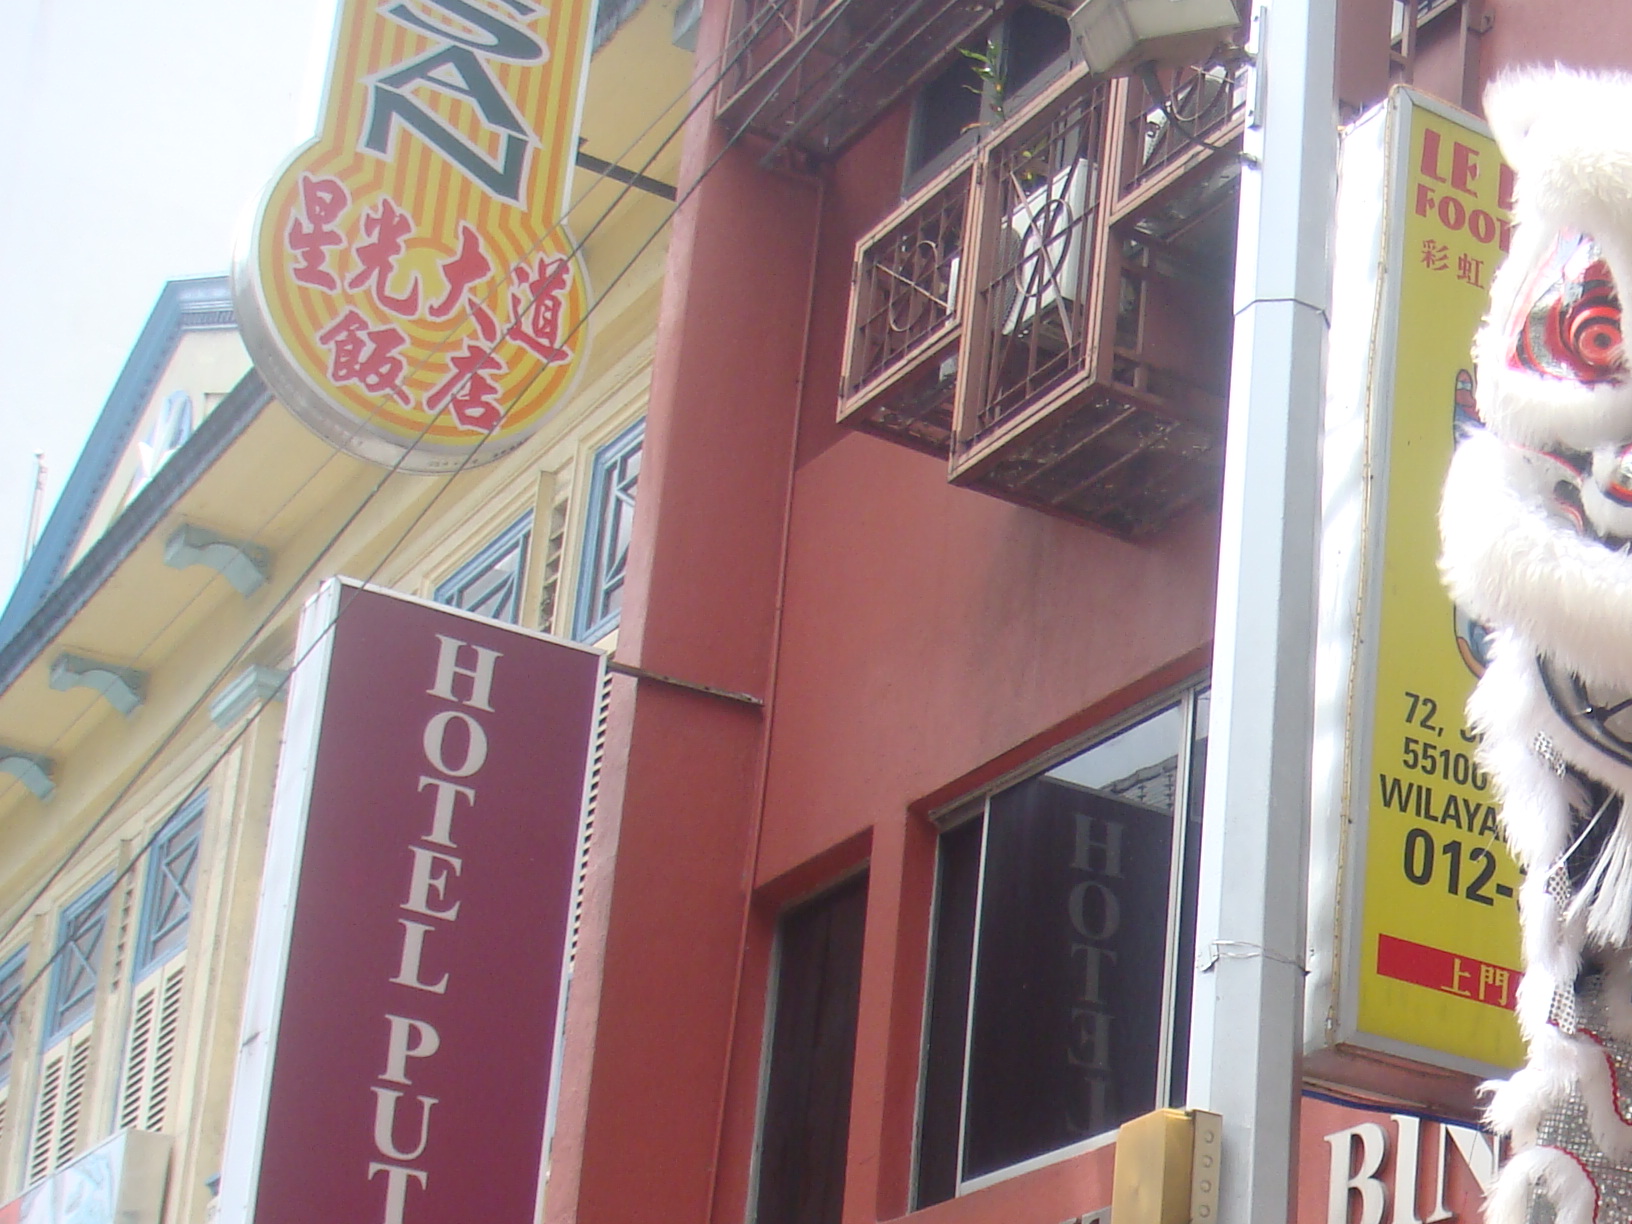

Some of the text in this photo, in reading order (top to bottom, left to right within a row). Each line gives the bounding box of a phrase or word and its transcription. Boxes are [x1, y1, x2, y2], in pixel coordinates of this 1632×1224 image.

[1420, 128, 1482, 199] LE
[287, 171, 573, 366] 星光大道
[1421, 238, 1485, 290] 彩虹
[316, 307, 506, 434] 飯店
[1404, 692, 1443, 737] 72,
[389, 633, 503, 995] HOTEL
[1379, 774, 1509, 843] WILAYA
[1404, 828, 1518, 907] 012-
[1441, 958, 1510, 1007] 上門
